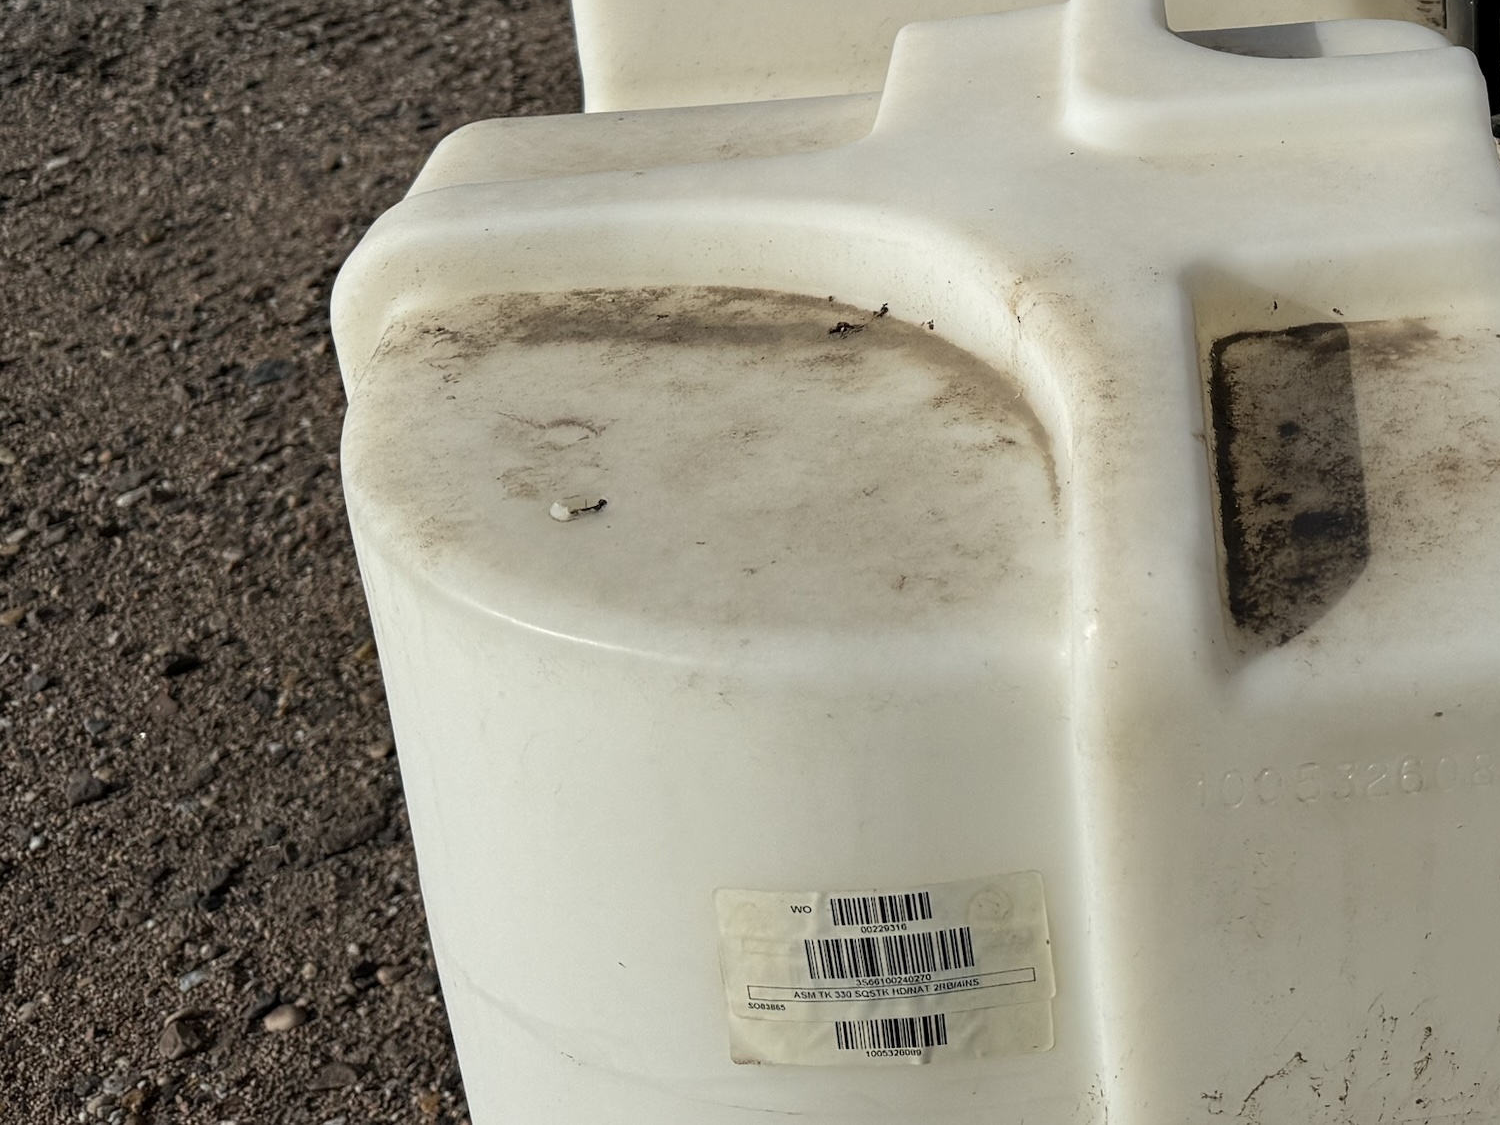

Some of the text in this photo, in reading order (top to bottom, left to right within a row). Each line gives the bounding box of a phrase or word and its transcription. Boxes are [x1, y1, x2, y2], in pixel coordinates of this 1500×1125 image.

[790, 905, 812, 914] WO
[793, 990, 817, 999] ASM
[819, 990, 833, 999] TK
[834, 990, 852, 999] 330
